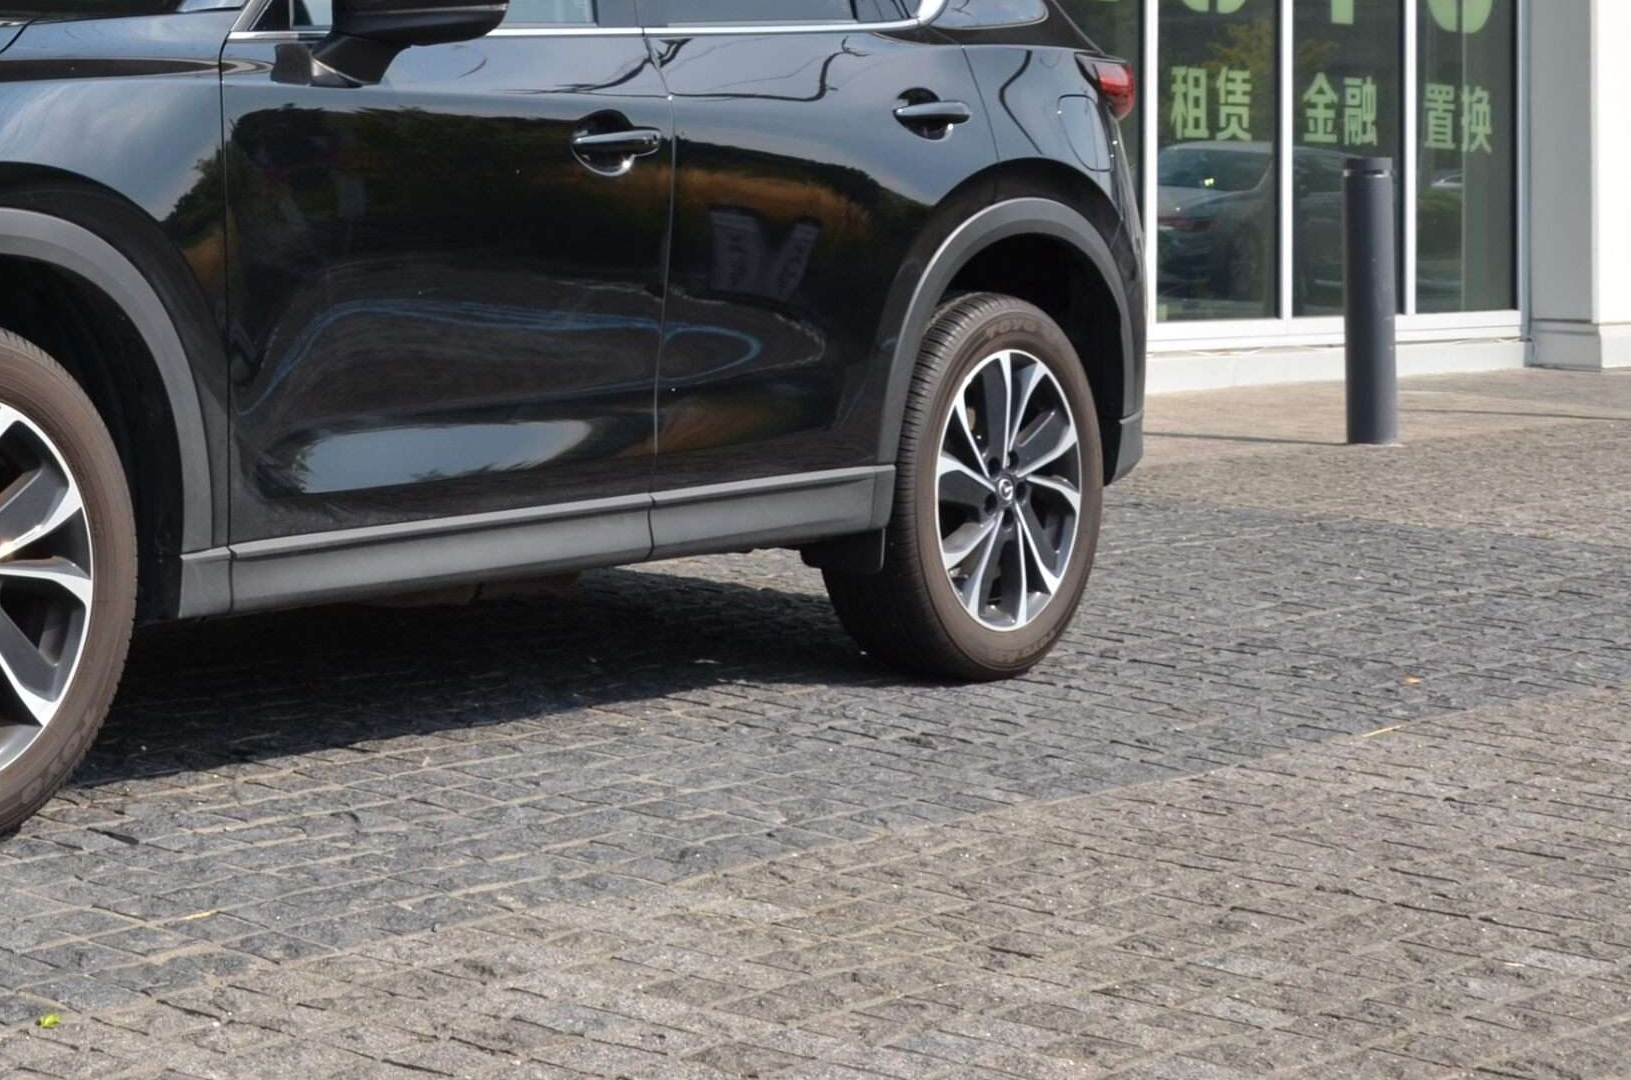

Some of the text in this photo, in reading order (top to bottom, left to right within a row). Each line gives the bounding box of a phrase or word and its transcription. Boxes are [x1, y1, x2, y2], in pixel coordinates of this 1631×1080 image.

[1170, 66, 1493, 154] 租赁 金融 置换
